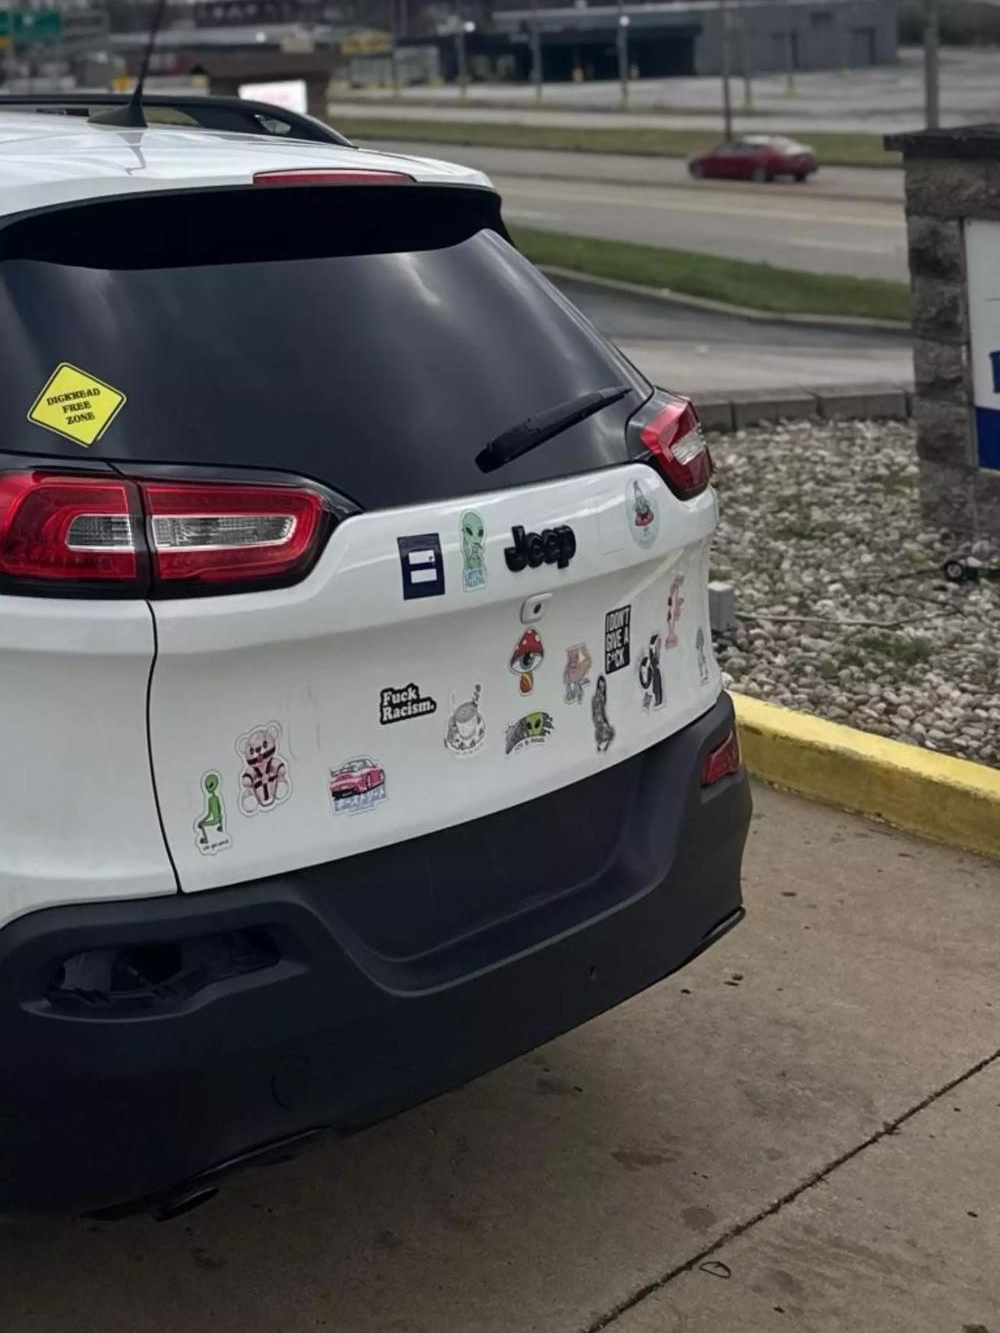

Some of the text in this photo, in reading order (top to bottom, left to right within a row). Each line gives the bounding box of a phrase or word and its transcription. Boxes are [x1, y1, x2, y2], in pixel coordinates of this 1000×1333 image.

[46, 387, 101, 406] DICKHEAD
[62, 400, 92, 414] FREE
[66, 411, 96, 425] ZONE
[504, 525, 576, 572] Jeep
[606, 628, 622, 652] GIVE
[383, 686, 418, 706] Fuck
[383, 701, 435, 722] Racism.
